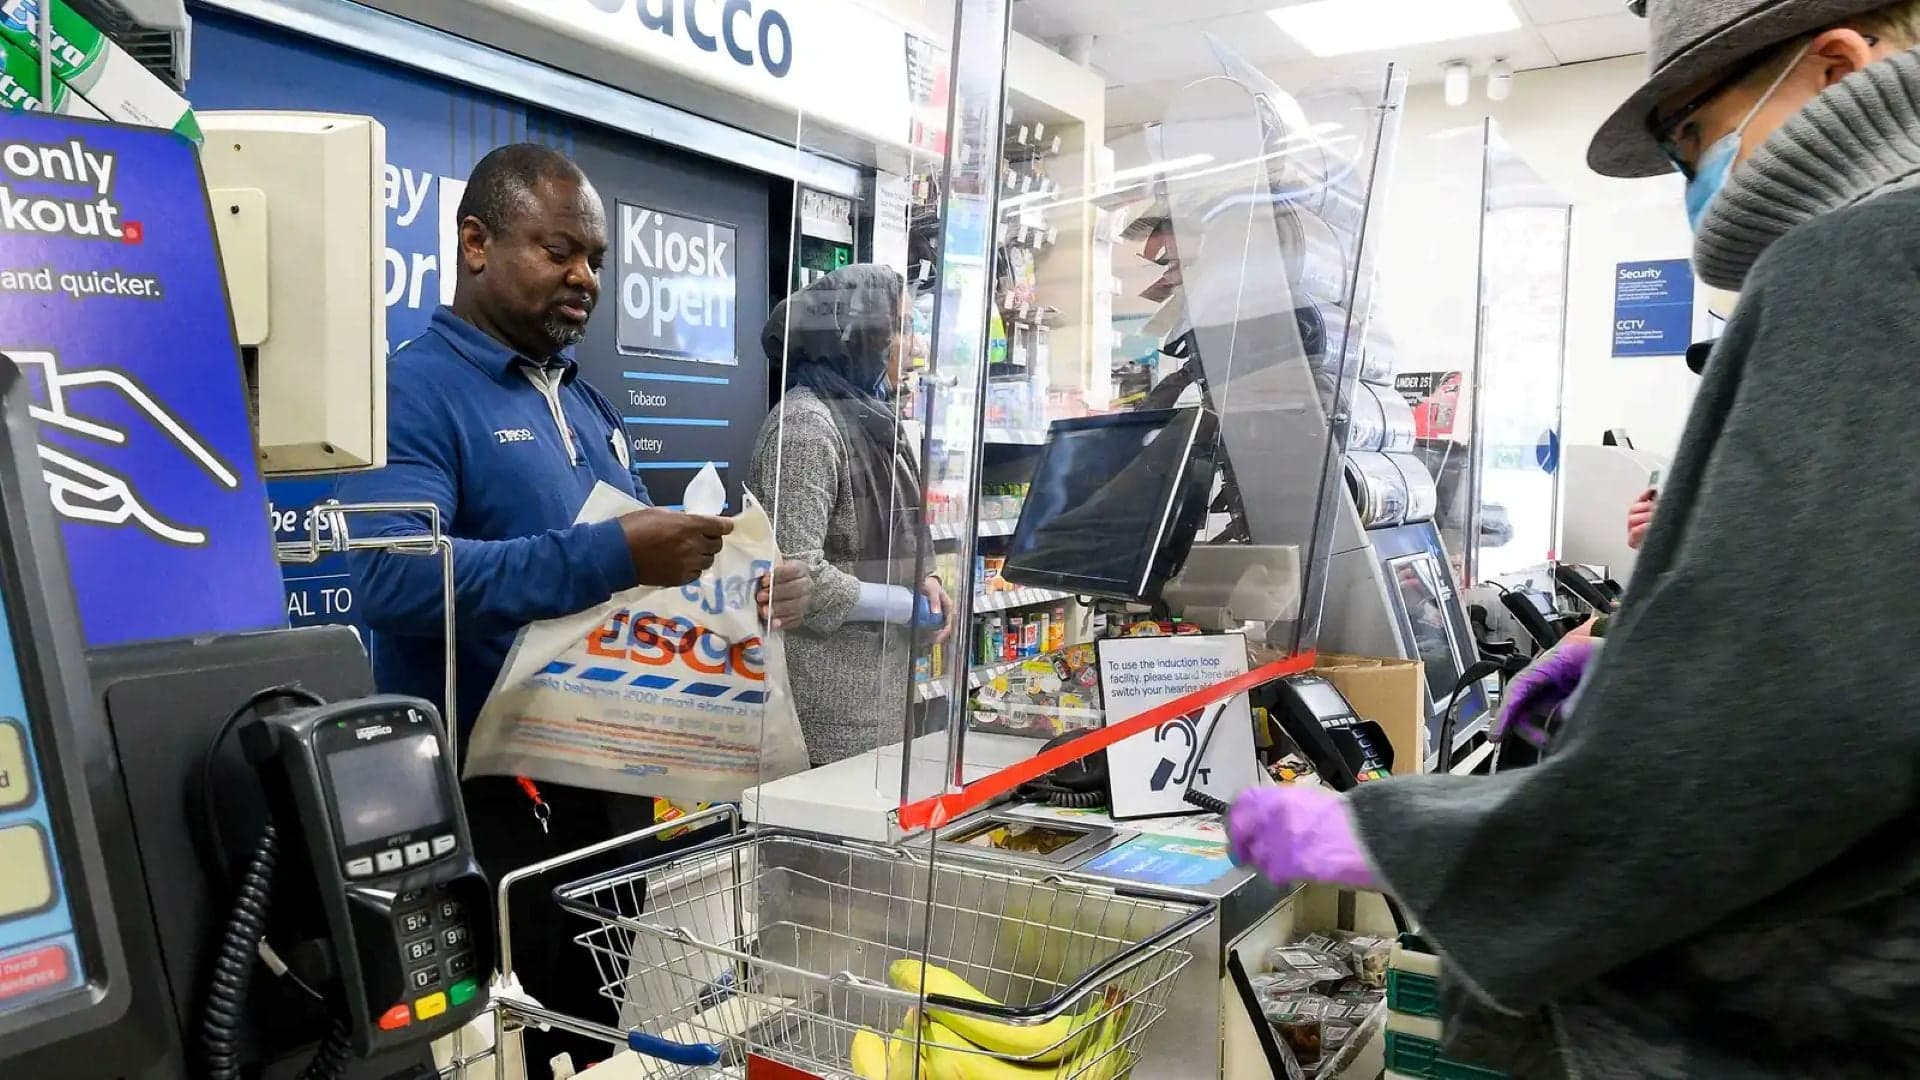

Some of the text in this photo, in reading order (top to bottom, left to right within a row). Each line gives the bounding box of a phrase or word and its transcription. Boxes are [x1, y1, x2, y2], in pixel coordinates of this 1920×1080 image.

[586, 0, 792, 78] acco
[0, 74, 42, 110] tra
[4, 141, 113, 194] only
[623, 205, 728, 279] Kiosk
[1, 268, 161, 297] and quicker.
[1619, 267, 1662, 279] Security
[623, 272, 728, 337] open
[1616, 319, 1645, 330] CCTV
[628, 389, 667, 407] Tobacco
[630, 435, 663, 454] ottery
[287, 587, 352, 616] AL TO
[1108, 660, 1119, 671] To
[1122, 661, 1137, 670] use
[1140, 660, 1155, 669] the
[1200, 657, 1220, 669] loop
[1144, 672, 1173, 684] please
[1174, 669, 1200, 680] stand
[1201, 669, 1222, 680] here
[1111, 687, 1141, 698] switch
[1142, 687, 1162, 698] your
[1198, 768, 1211, 785] T
